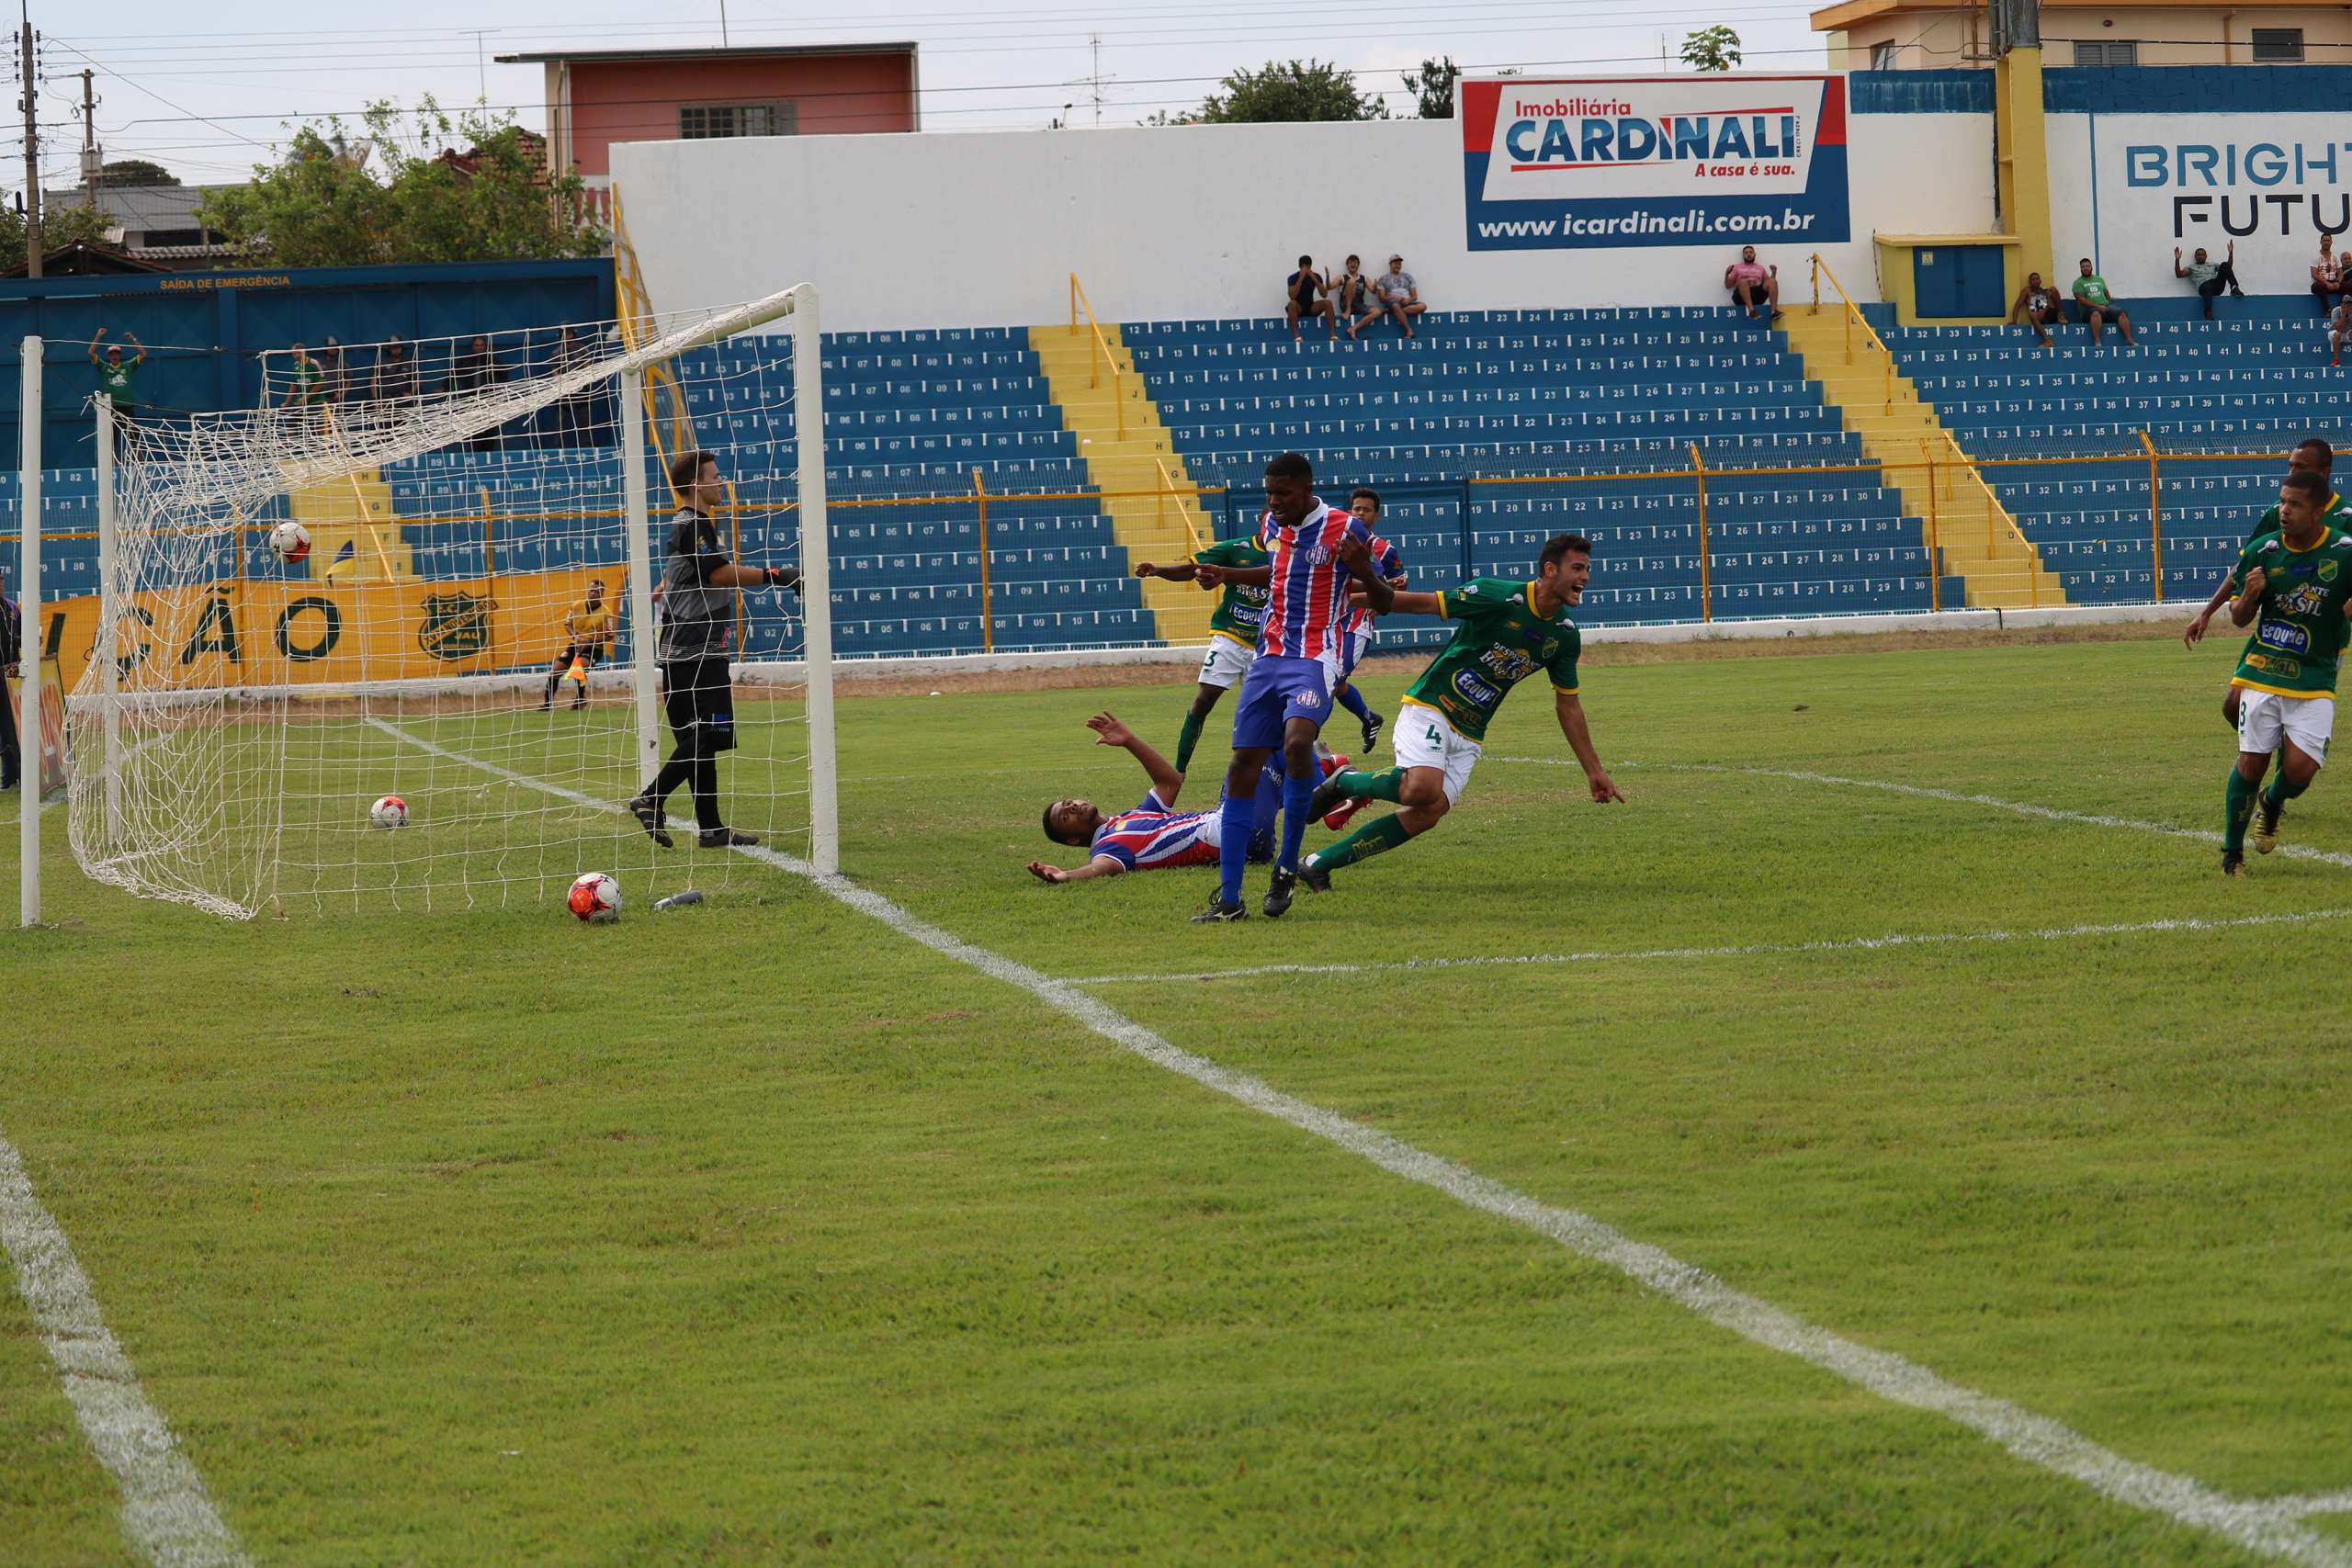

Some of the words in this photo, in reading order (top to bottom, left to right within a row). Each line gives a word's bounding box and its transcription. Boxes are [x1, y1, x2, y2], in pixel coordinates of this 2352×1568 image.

[1515, 98, 1631, 117] Imobiliária
[1505, 116, 1794, 162] CARDINALI
[1695, 164, 1706, 176] A
[1710, 165, 1745, 176] casa
[1749, 162, 1759, 175] é
[1763, 164, 1795, 175] sua.
[1478, 219, 1555, 237] www
[1563, 209, 1815, 235] icardinali.com.br
[160, 279, 193, 289] SAÍDA
[197, 279, 211, 288] DE
[215, 276, 289, 288] EMERGÊNCIA
[1981, 329, 1991, 337] 34
[2075, 327, 2086, 335] 37
[2139, 326, 2148, 334] 39
[1139, 351, 1149, 359] 12
[1173, 349, 1182, 357] 13
[1208, 348, 1217, 356] 14
[1242, 346, 1252, 355] 15
[1344, 344, 1353, 353] 18
[1411, 342, 1422, 350] 20
[1446, 341, 1455, 349] 21
[1477, 341, 1487, 349] 22
[1512, 340, 1523, 348] 23
[1545, 339, 1557, 347] 24
[1581, 338, 1591, 346] 25
[1612, 337, 1624, 345] 26
[1647, 336, 1658, 344] 27
[1713, 335, 1724, 344] 29
[1747, 334, 1757, 343] 30
[963, 356, 973, 365] 10
[998, 355, 1007, 364] 11
[1924, 380, 1933, 389] 31
[1956, 380, 1966, 389] 32
[1988, 379, 1998, 388] 33
[2020, 378, 2030, 387] 34
[2052, 378, 2062, 386] 35
[2085, 377, 2094, 385] 36
[2117, 376, 2126, 384] 37
[2148, 375, 2158, 383] 38
[2304, 371, 2314, 379] 43
[1270, 400, 1281, 409] 15
[1305, 399, 1315, 407] 16
[1340, 398, 1349, 406] 17
[1442, 394, 1453, 402] 20
[1476, 393, 1487, 401] 21
[1509, 392, 1520, 401] 22
[1579, 390, 1589, 399] 24
[1613, 389, 1624, 398] 25
[1646, 387, 1658, 397] 26
[1681, 387, 1692, 395] 27
[1747, 386, 1758, 394] 29
[1782, 385, 1792, 393] 30
[2006, 488, 2015, 496] 31
[2039, 486, 2050, 494] 32
[2073, 485, 2083, 493] 33
[2107, 484, 2116, 492] 34
[2139, 482, 2149, 491] 35
[2172, 481, 2181, 490] 36
[2205, 481, 2214, 490] 37
[2237, 479, 2247, 488] 38
[1471, 505, 1482, 514] 19
[1507, 504, 1518, 513] 20
[1542, 503, 1553, 512] 21
[1575, 502, 1586, 511] 22
[1611, 501, 1623, 510] 23
[1646, 500, 1658, 509] 24
[1683, 498, 1694, 506] 25
[1718, 497, 1729, 505] 26
[1753, 496, 1764, 504] 27
[1786, 495, 1798, 503] 28
[1822, 493, 1834, 502] 29
[1858, 492, 1868, 501] 30
[849, 529, 860, 537] 05
[886, 527, 897, 536] 06
[923, 526, 934, 535] 07
[959, 525, 969, 533] 08
[997, 523, 1008, 531] 09
[1035, 522, 1045, 530] 10
[1071, 520, 1081, 529] 11
[2070, 576, 2080, 584] 31
[2105, 575, 2116, 583] 32
[2140, 573, 2150, 581] 33
[2173, 572, 2183, 581] 35
[2207, 571, 2217, 580] 35
[1204, 650, 1217, 667] 3
[1426, 724, 1442, 744] 4
